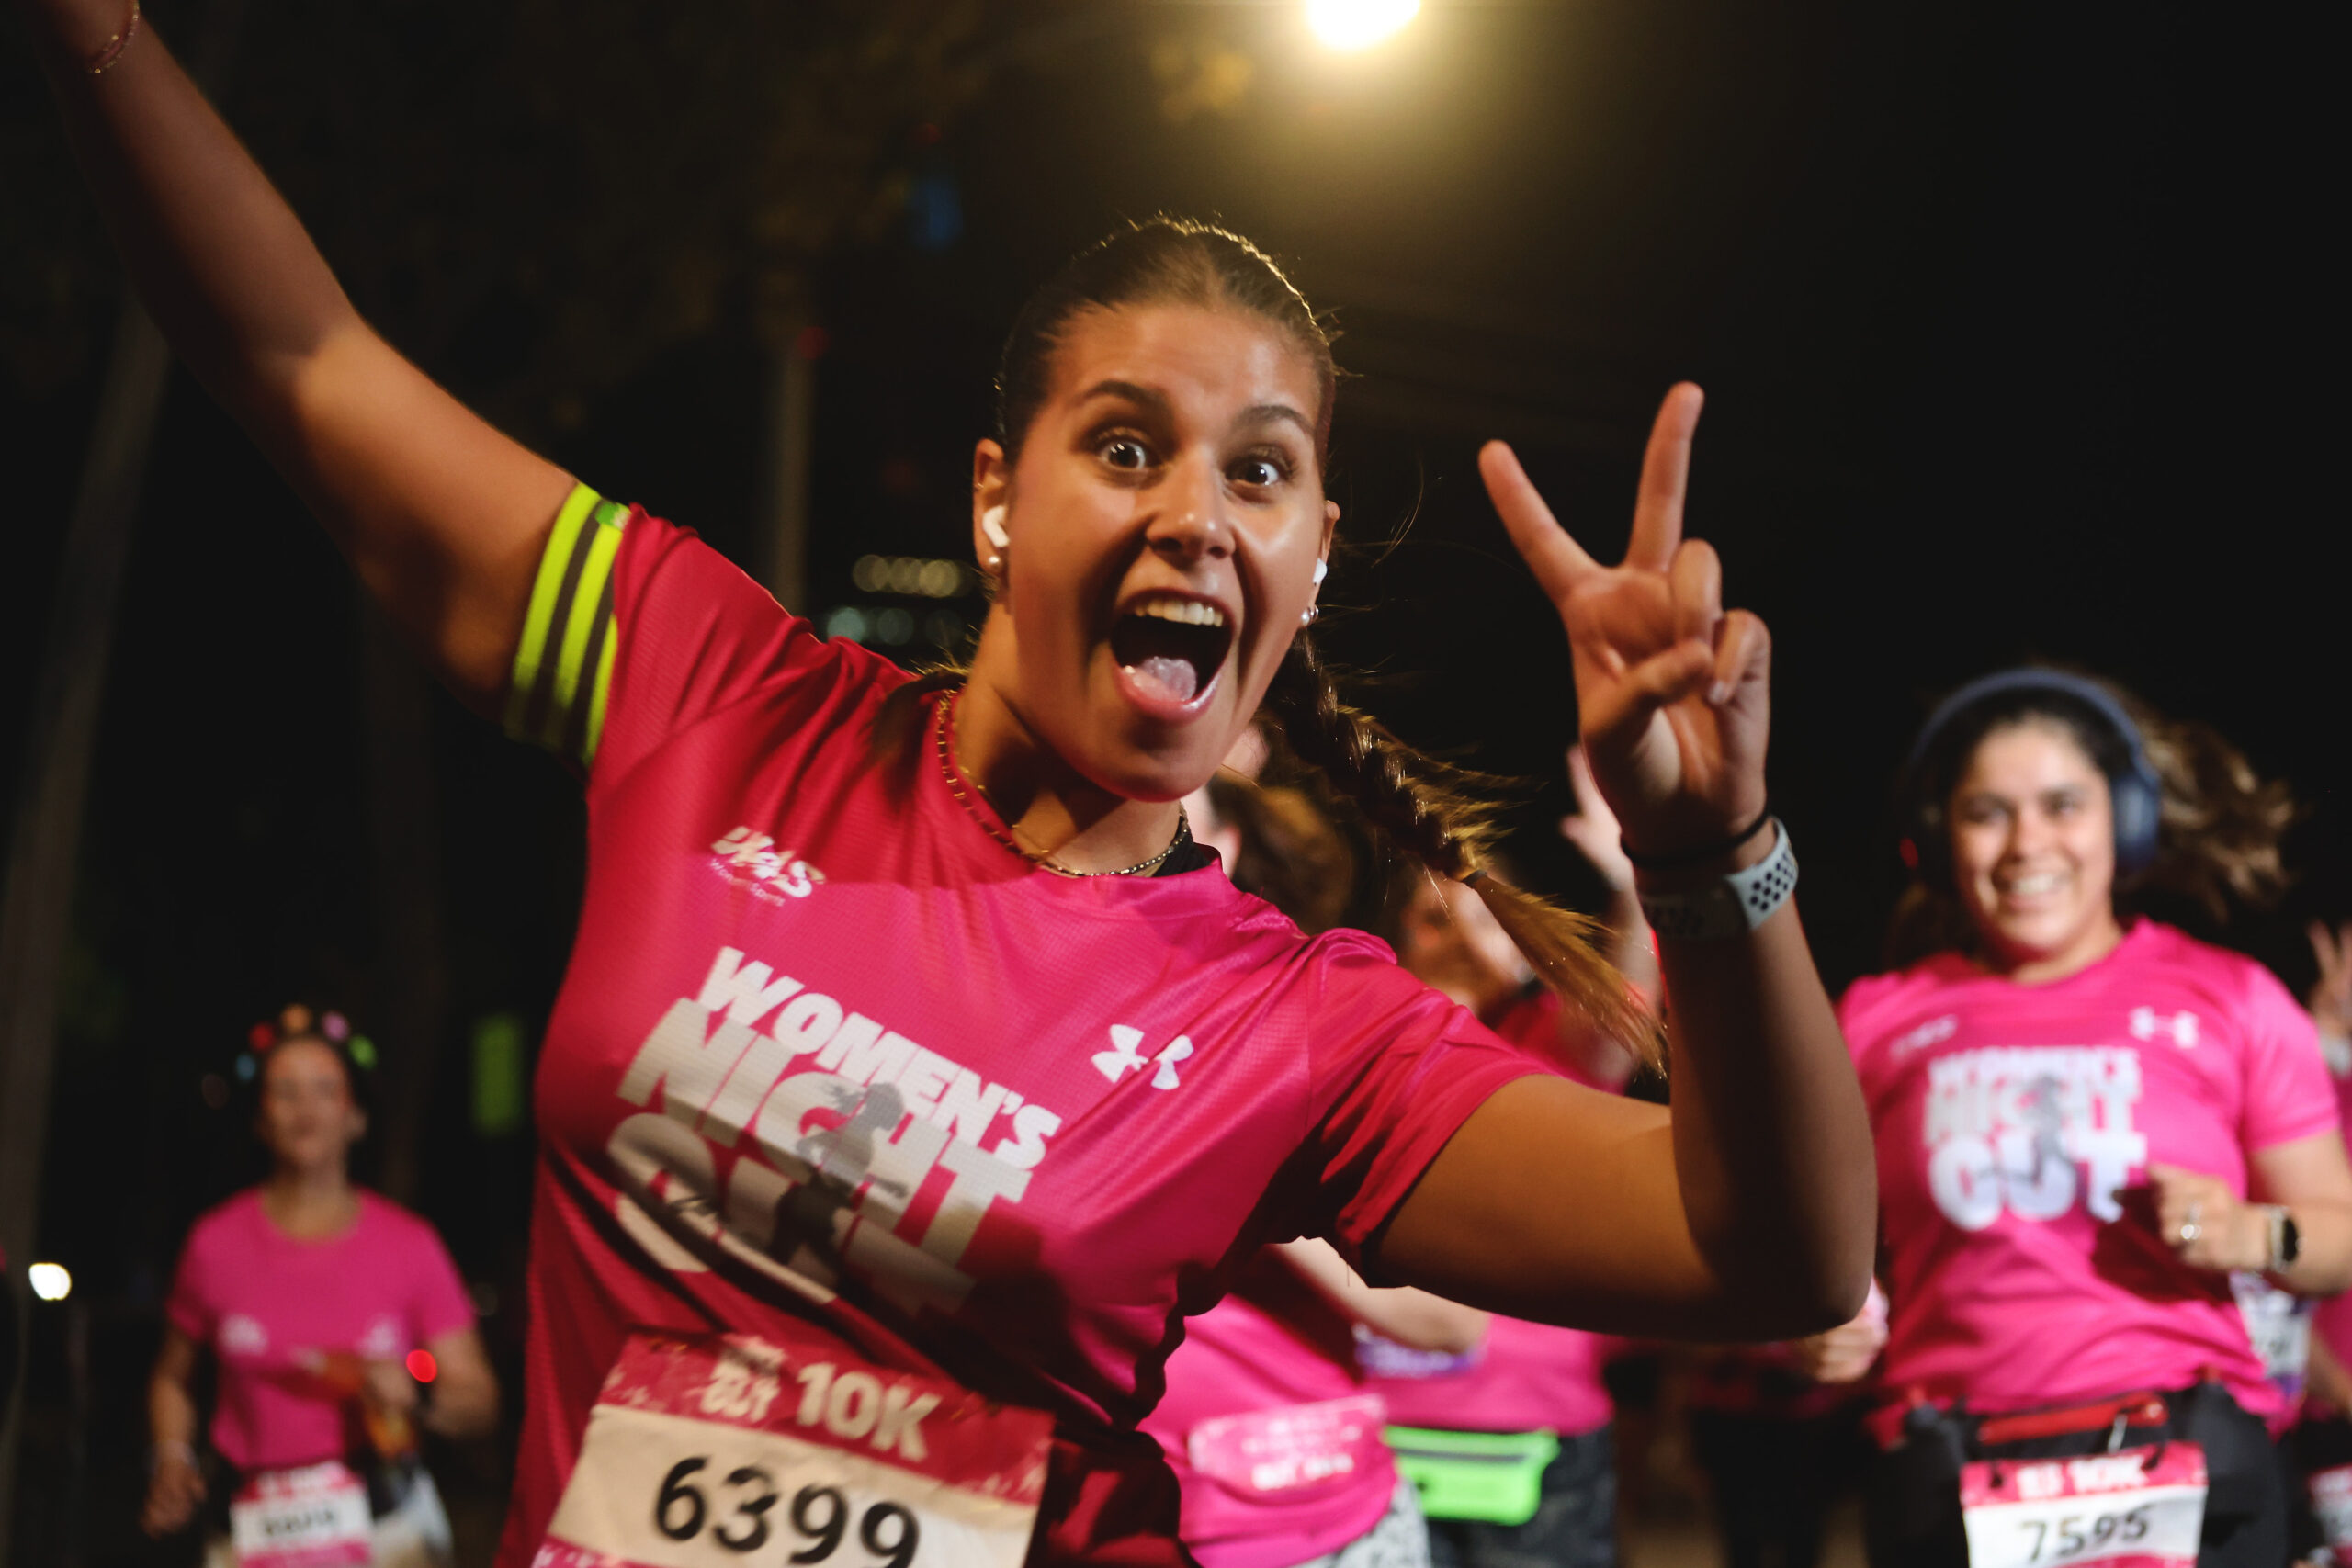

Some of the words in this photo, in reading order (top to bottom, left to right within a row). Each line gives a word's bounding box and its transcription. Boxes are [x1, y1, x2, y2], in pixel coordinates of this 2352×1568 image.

[696, 945, 1063, 1171] WOMEN'S
[616, 997, 1035, 1269] NIGHT
[795, 1360, 944, 1462] 10K
[655, 1455, 922, 1568] 6399
[2018, 1503, 2155, 1564] 7595
